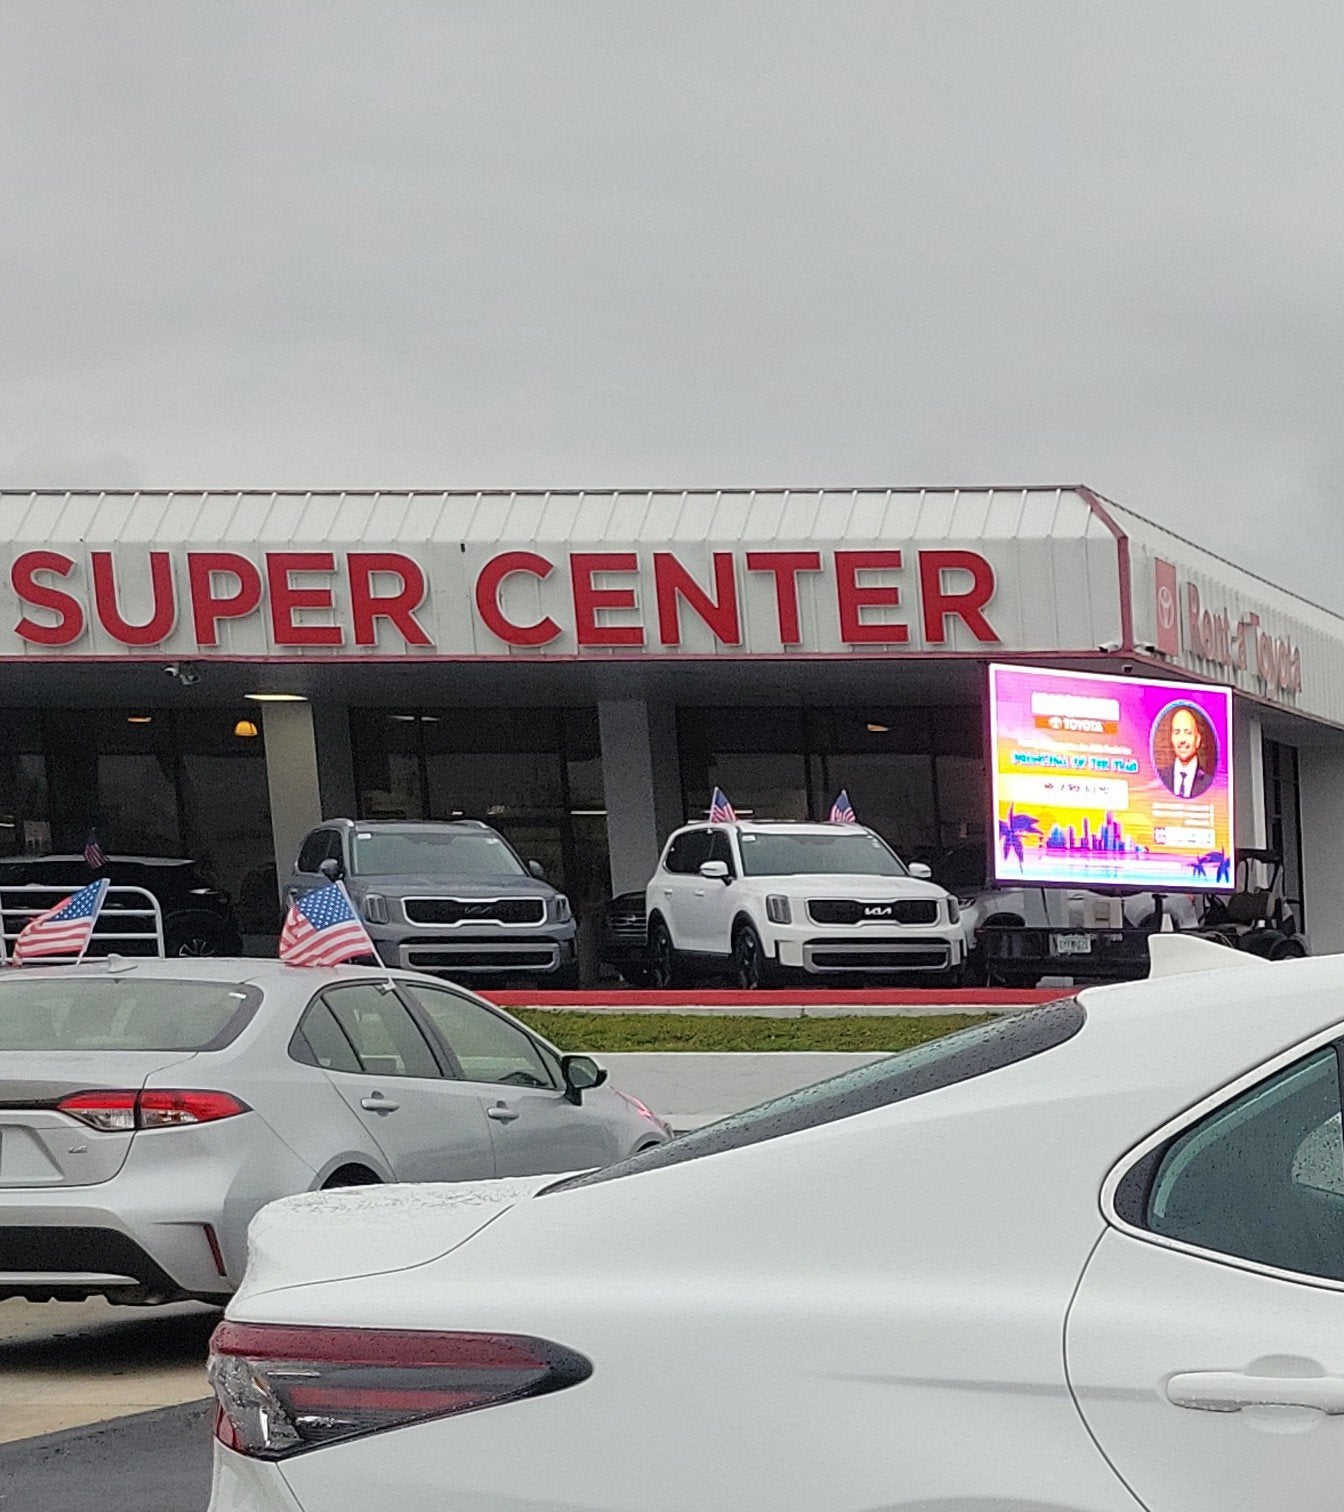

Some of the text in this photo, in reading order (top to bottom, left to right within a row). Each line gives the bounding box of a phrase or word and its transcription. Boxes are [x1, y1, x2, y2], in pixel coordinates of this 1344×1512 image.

[10, 549, 1003, 647] SUPER CENTER
[1183, 581, 1232, 668] Rent
